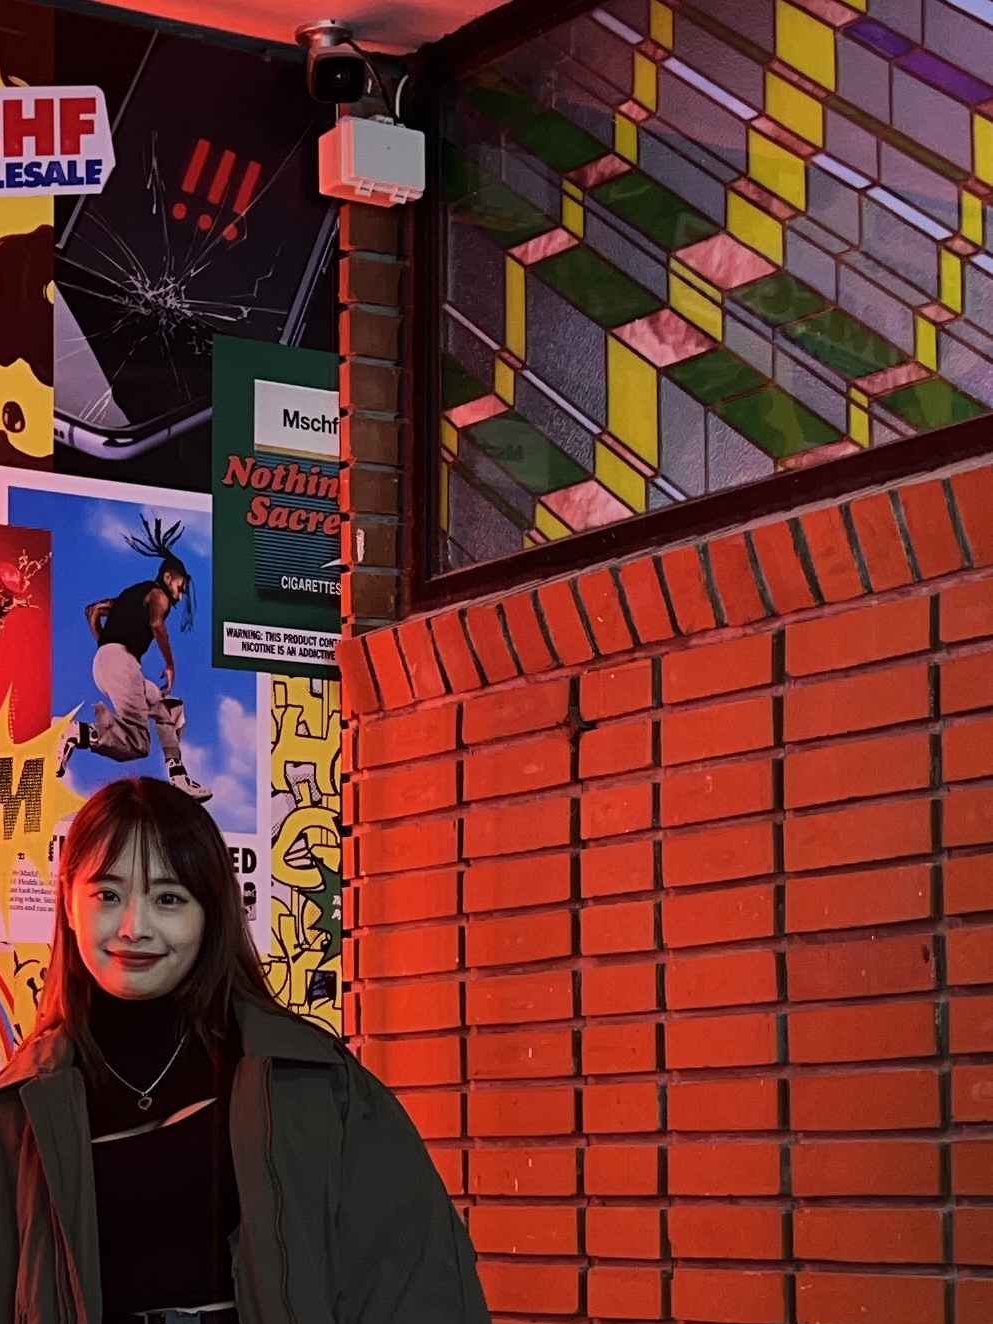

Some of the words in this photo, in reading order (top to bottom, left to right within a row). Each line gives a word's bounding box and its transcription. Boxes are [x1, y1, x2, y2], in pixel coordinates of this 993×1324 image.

[283, 409, 340, 435] Mschf
[221, 454, 340, 499] Nothin
[246, 495, 340, 536] Sacre
[281, 576, 341, 595] CIGARETTES
[265, 631, 281, 643] THIS
[283, 633, 317, 647] PRODUCT
[241, 641, 275, 654] NICOTINE
[277, 645, 285, 656] IS
[287, 646, 296, 656] AN
[298, 647, 336, 660] ADDICTIVE
